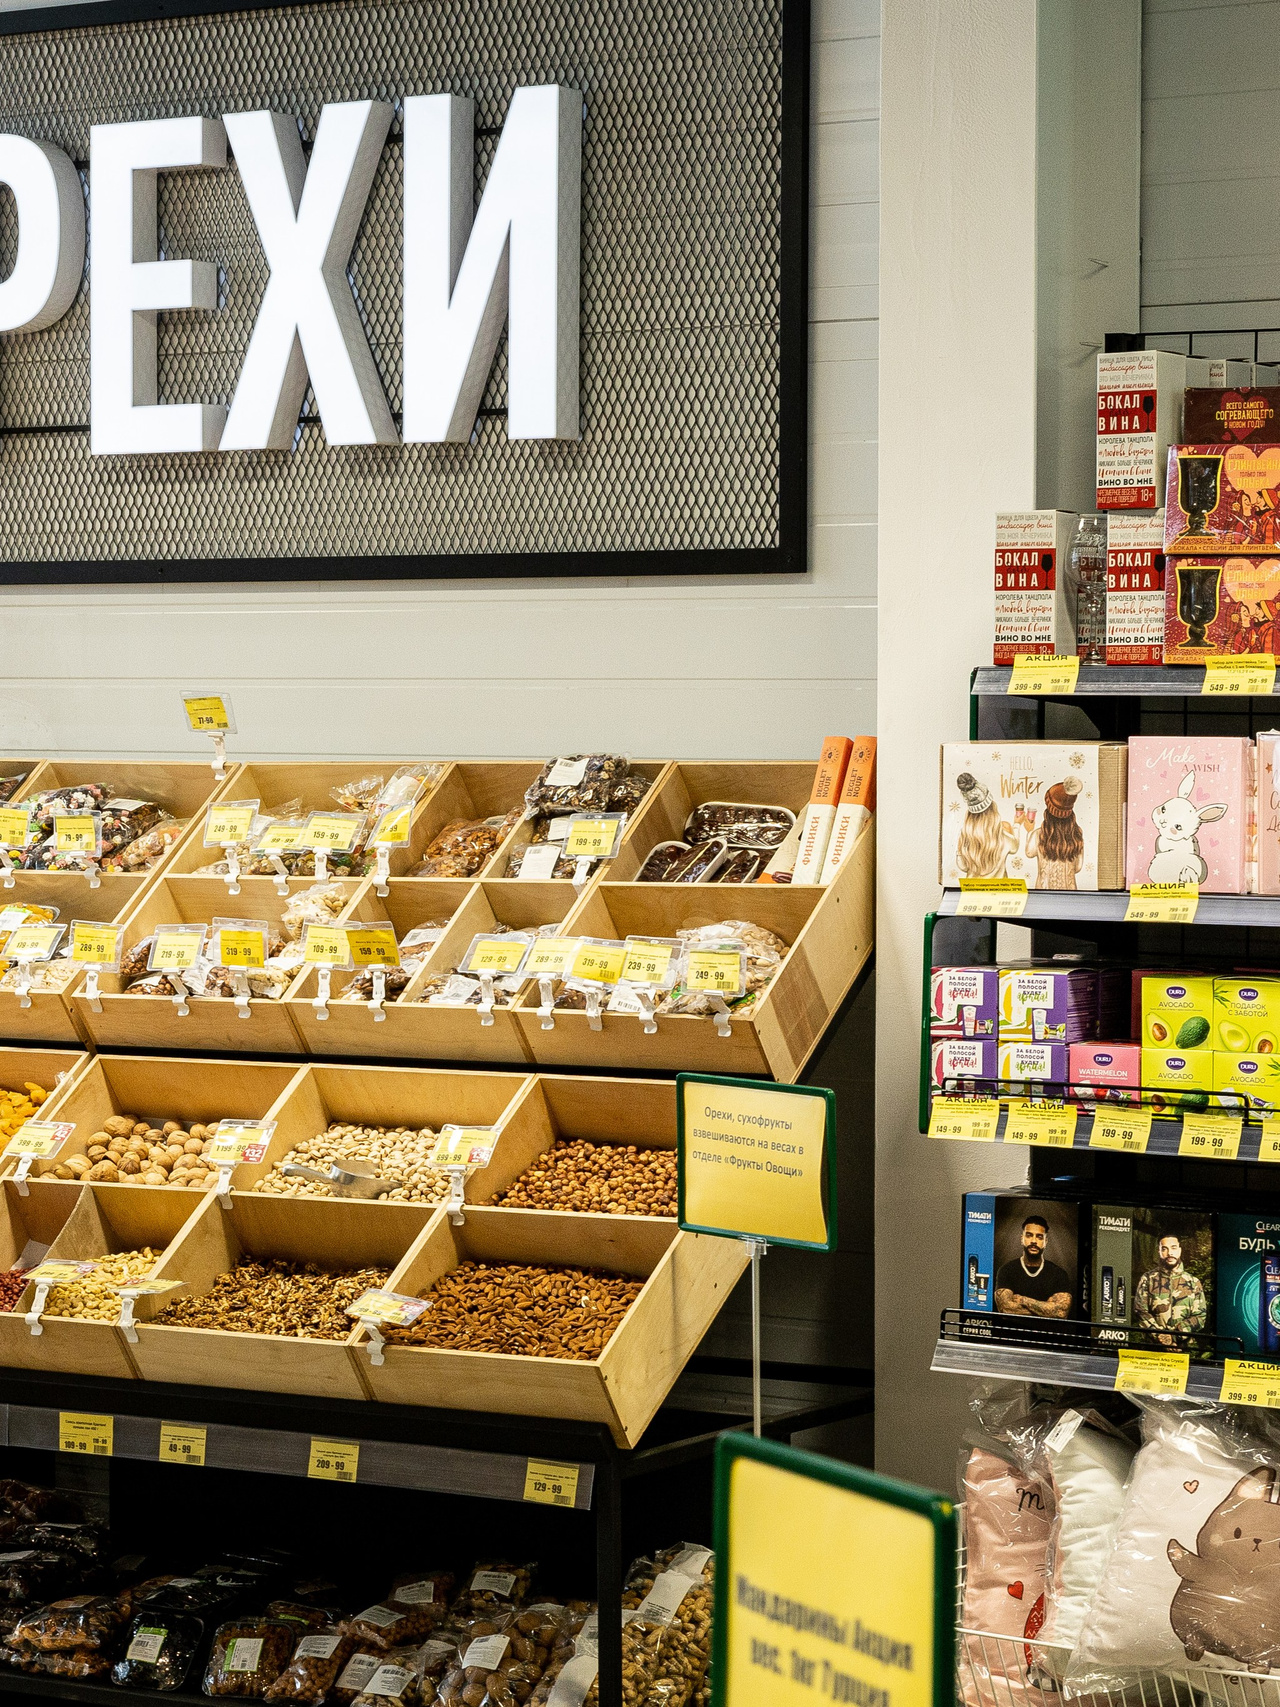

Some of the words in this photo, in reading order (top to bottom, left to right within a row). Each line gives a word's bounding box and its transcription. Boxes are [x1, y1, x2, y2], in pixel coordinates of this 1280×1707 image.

[1098, 394, 1140, 410] БОКАЛ
[1243, 400, 1264, 409] САМОГО
[1216, 408, 1274, 420] СОГРЕВАЮЩЕГО
[1098, 415, 1140, 431] ВИНА
[1098, 478, 1121, 487] ВИНО
[1123, 478, 1135, 486] ВО
[1136, 477, 1154, 485] МНЕ
[1140, 488, 1154, 502] 18+
[995, 552, 1038, 566] БОКАЛ
[1108, 552, 1151, 567] БОКАЛ
[995, 573, 1038, 588] ВИНА
[1108, 573, 1151, 588] ВИНА
[1021, 634, 1033, 642] ВО
[1035, 634, 1052, 642] МНЕ
[1134, 635, 1147, 643] ВО
[1025, 654, 1068, 662] АКЦИЯ
[1010, 756, 1034, 771] HELLO,
[1146, 746, 1196, 769] Make
[1194, 763, 1220, 773] WISH
[821, 775, 832, 798] NOUR
[852, 775, 863, 798] NOUR
[1000, 771, 1044, 799] Winter
[801, 815, 820, 865] ФИНИКИ
[831, 815, 851, 865] ФИНИКИ
[1140, 882, 1186, 891] АКЦИЯ
[1158, 1001, 1195, 1009] AVOCADO
[1230, 1002, 1267, 1010] ПОДАРОК
[1078, 1068, 1128, 1077] WATERMELON
[1157, 1072, 1194, 1080] AVOCADO
[1021, 1102, 1064, 1110] АКЦИЯ
[704, 1106, 735, 1122] Орехи,
[737, 1112, 793, 1130] сухофрукты
[693, 1128, 756, 1147] взвешиваются
[757, 1139, 769, 1149] на
[770, 1142, 796, 1154] весах
[798, 1146, 804, 1155] в
[692, 1150, 722, 1164] отделе
[724, 1154, 763, 1171] «Фрукты
[765, 1160, 803, 1178] Овощи»
[967, 1211, 992, 1220] ТИМАТИ
[1098, 1216, 1131, 1226] ТИМАТИ
[1238, 1237, 1276, 1253] БУДЬ
[1098, 1329, 1126, 1341] ARKO
